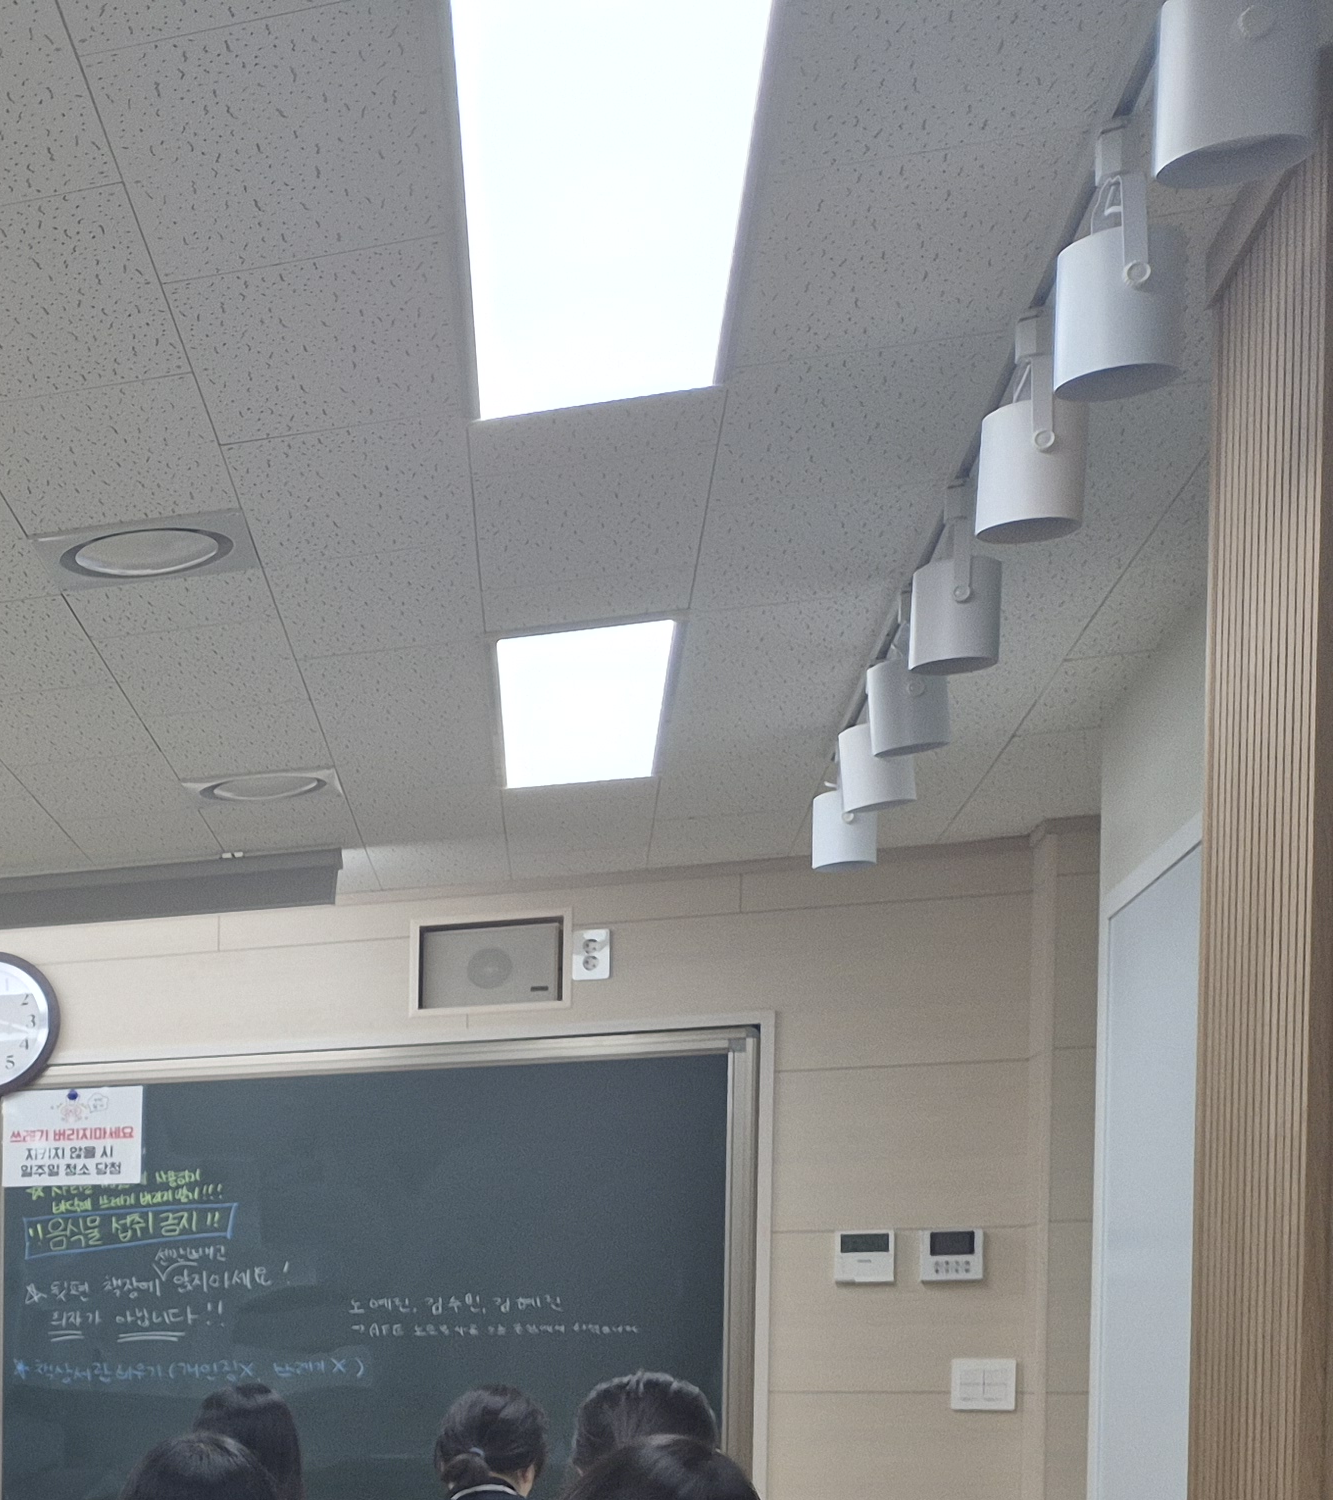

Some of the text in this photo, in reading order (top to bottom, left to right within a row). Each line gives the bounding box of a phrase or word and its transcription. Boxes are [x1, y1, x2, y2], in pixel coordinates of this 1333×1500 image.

[21, 994, 30, 1006] 2
[25, 1014, 36, 1028] 3
[19, 1038, 29, 1050] 4
[5, 1055, 15, 1069] 5
[53, 1126, 134, 1141] 버리지마세요
[25, 1145, 114, 1161] 지키지 않을 시
[21, 1162, 122, 1178] 일주일 청소 당첨
[45, 1215, 103, 1251] 음식물
[159, 1211, 197, 1237] 금지
[50, 1309, 102, 1326] 의자가
